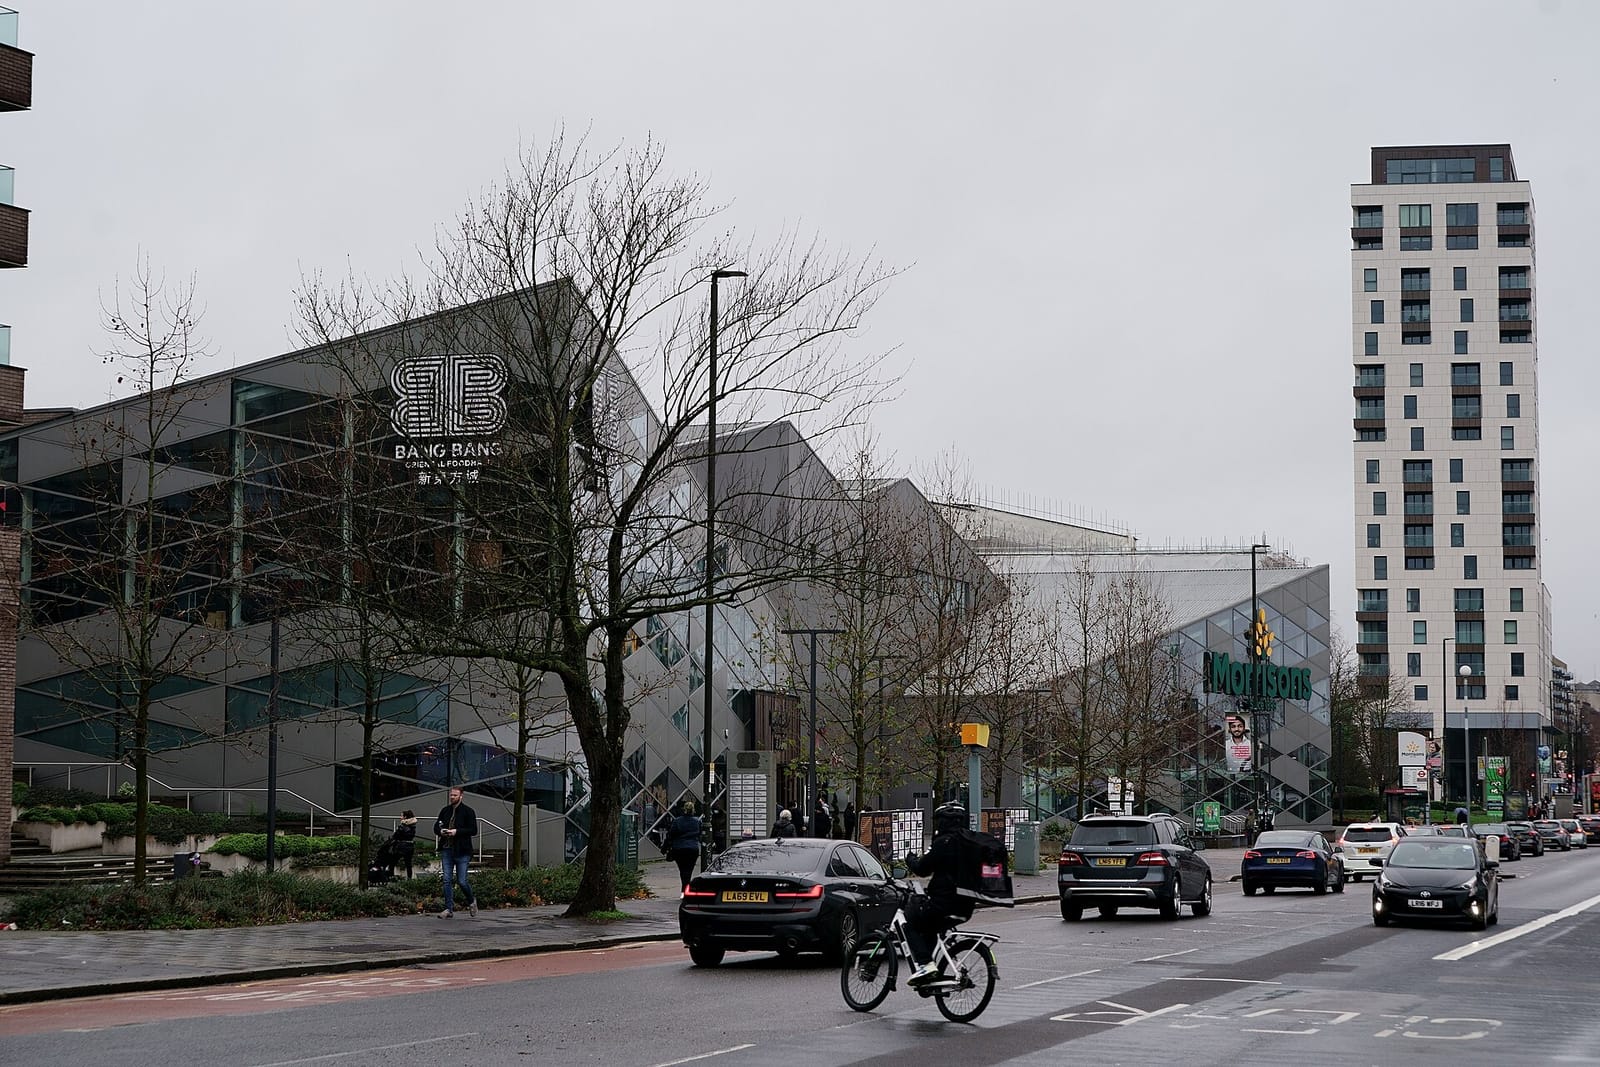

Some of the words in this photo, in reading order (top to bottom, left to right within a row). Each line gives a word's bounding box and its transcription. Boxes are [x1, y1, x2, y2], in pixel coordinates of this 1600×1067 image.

[395, 443, 447, 459] BANG
[451, 441, 504, 457] BANG
[1209, 651, 1313, 701] Morrisons
[726, 892, 747, 900] LA69
[749, 892, 765, 900] EVL
